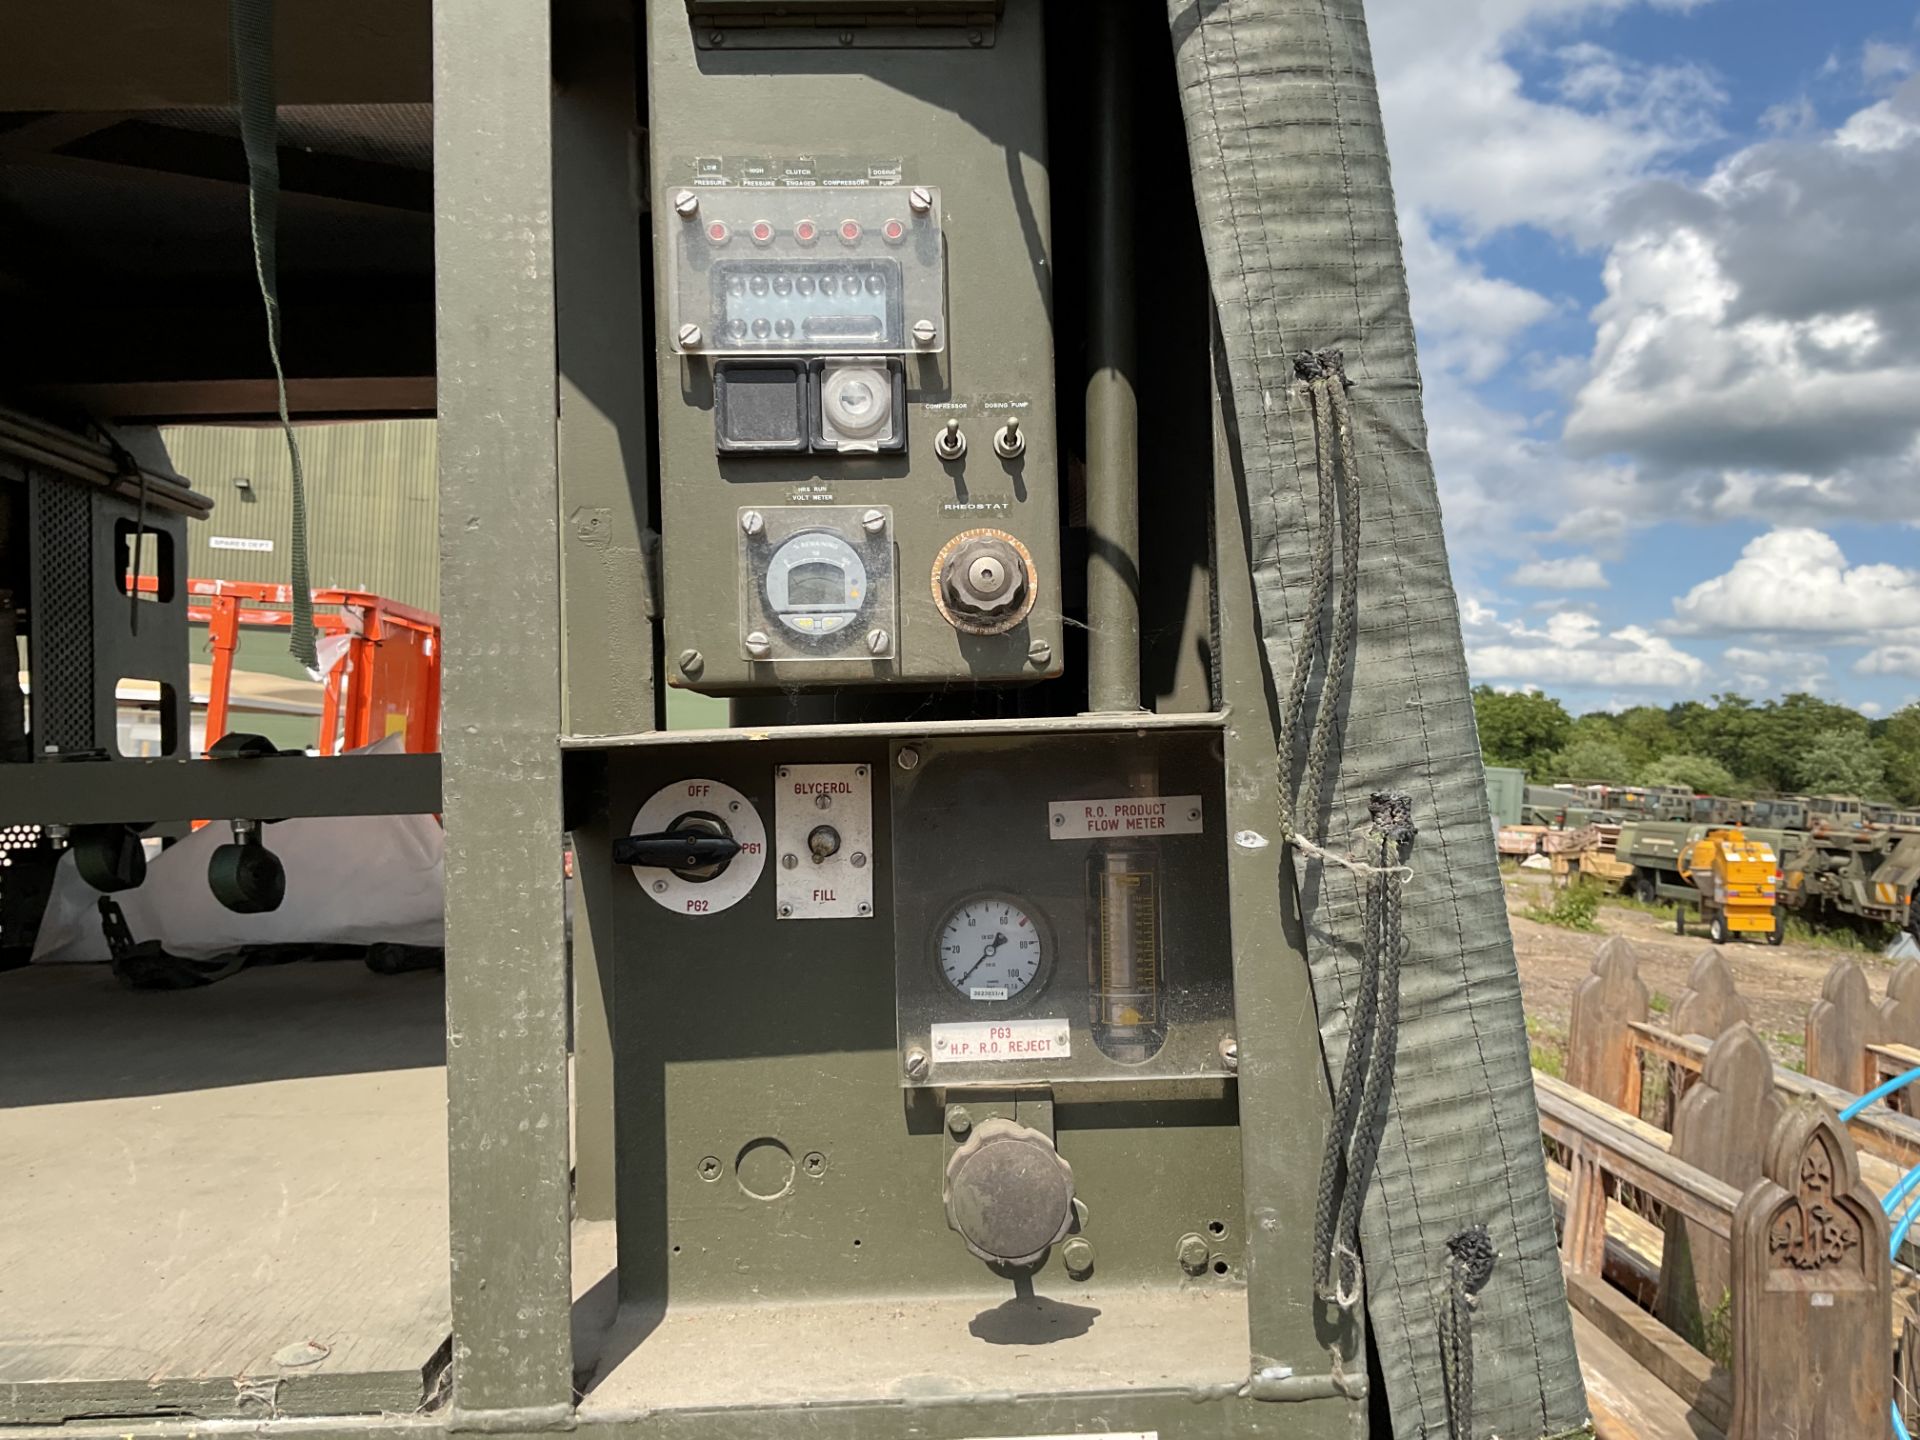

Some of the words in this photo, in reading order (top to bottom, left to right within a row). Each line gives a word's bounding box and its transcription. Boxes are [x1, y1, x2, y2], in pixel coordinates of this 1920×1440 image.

[688, 785, 710, 797] OFF
[794, 782, 852, 794] GLYCEROL
[1085, 806, 1108, 818] R.O.
[1114, 803, 1167, 817] PRODUCT
[1087, 819, 1119, 832] FLOW
[1126, 817, 1166, 830] METER
[742, 843, 761, 854] PG1
[813, 889, 836, 902] FILL
[686, 900, 709, 912] PG2
[968, 918, 976, 927] 40
[1000, 916, 1008, 925] 60
[952, 945, 960, 954] 20
[1020, 941, 1028, 949] 80
[1008, 969, 1020, 978] 100
[990, 1027, 1012, 1039] PG3
[979, 1042, 1001, 1054] R.O.
[1008, 1039, 1052, 1053] REJECT
